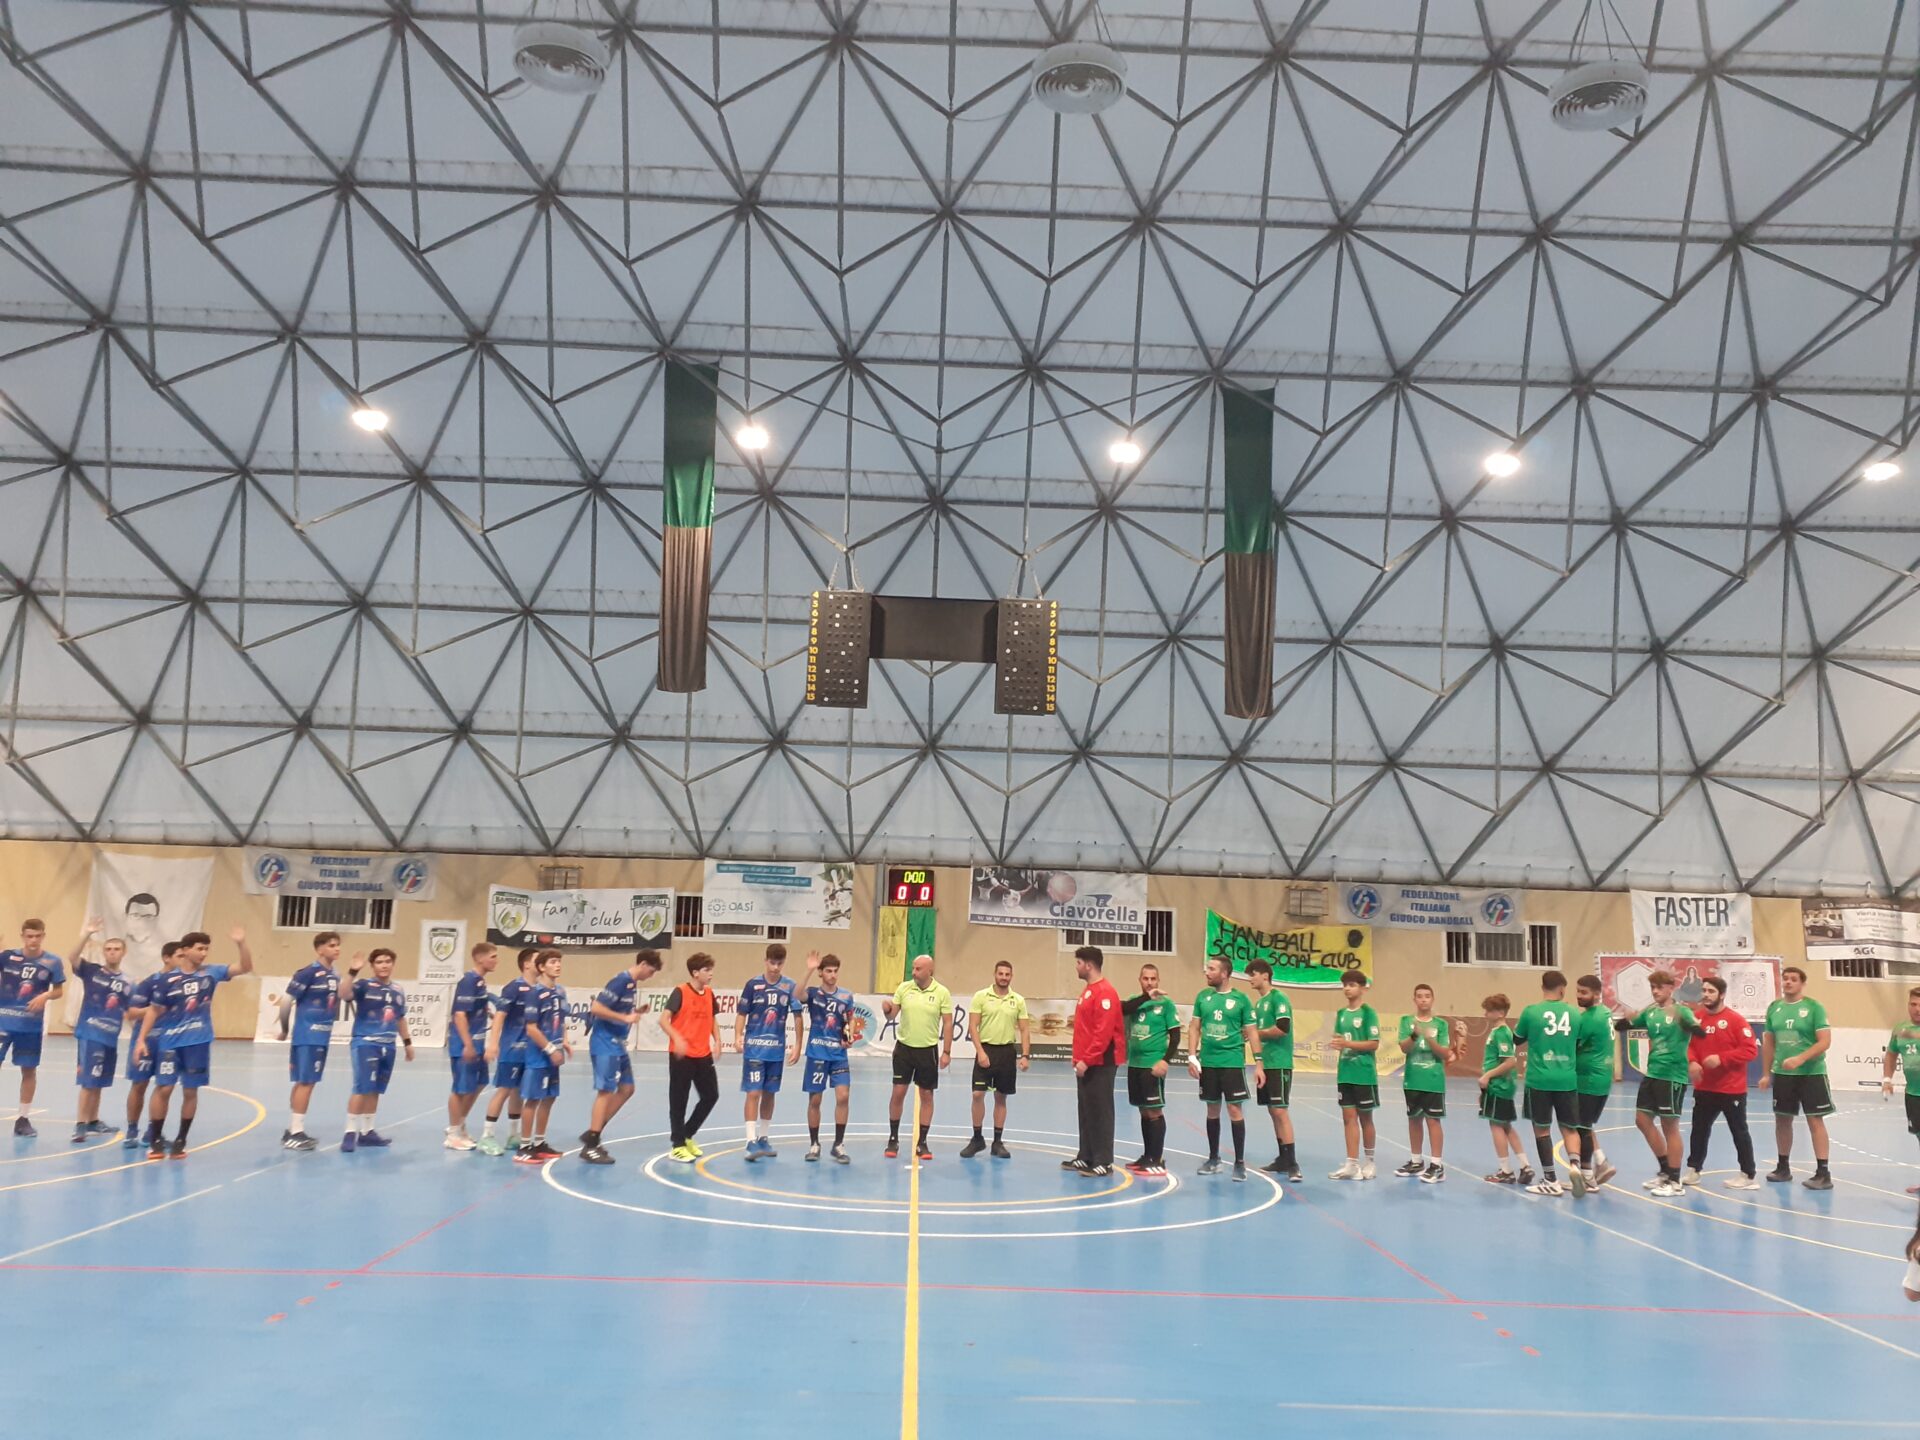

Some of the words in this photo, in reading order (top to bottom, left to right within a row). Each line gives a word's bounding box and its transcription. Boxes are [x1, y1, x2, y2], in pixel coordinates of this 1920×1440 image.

[897, 886, 907, 900] 0
[920, 887, 930, 900] 0
[1401, 889, 1461, 901] FEDERAZIONE
[542, 900, 568, 918] fan
[590, 911, 622, 926] club
[1050, 903, 1138, 922] Ciavorella
[1410, 903, 1451, 912] ITALIANA
[1654, 897, 1730, 926] FASTER
[1390, 913, 1425, 924] GIUOCO
[1428, 915, 1474, 925] HANDBALL
[553, 936, 584, 945] Scicli
[586, 936, 634, 945] Handball
[1220, 920, 1322, 953] HANDBALL
[1321, 952, 1361, 969] CLUB
[21, 967, 36, 979] 67
[406, 995, 441, 1003] ESTRA
[767, 993, 778, 1005] 18
[1213, 1010, 1223, 1021] 16
[1543, 1011, 1571, 1036] 34
[1706, 1025, 1716, 1034] 20
[1785, 1019, 1795, 1029] 17
[1846, 1054, 1861, 1063] La
[750, 1071, 760, 1083] 18
[812, 1072, 824, 1084] 27
